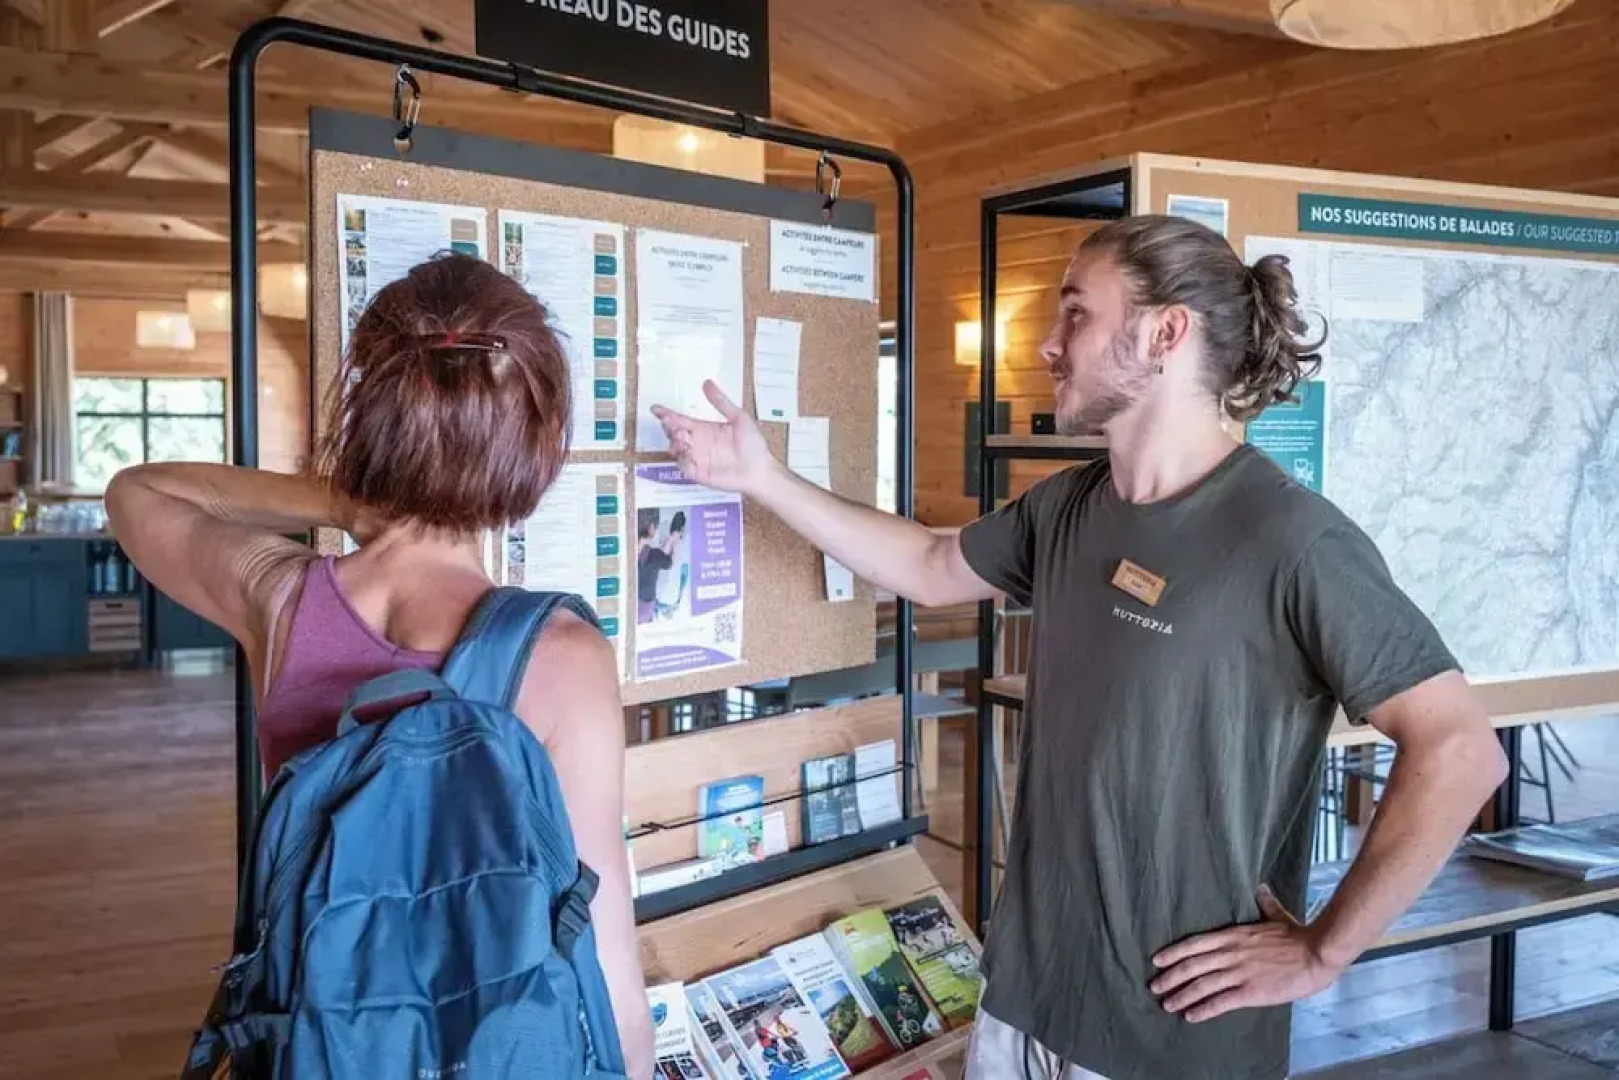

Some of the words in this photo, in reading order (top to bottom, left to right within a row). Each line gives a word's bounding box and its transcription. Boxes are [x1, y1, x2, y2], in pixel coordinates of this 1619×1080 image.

[616, 2, 661, 36] DES
[667, 14, 751, 59] GUIDES
[1311, 206, 1342, 224] NOS
[1344, 210, 1437, 232] SUGGESTIONS
[1440, 216, 1457, 233] DE
[1459, 218, 1514, 237] BALADES
[1523, 224, 1549, 241] OUR
[1550, 226, 1612, 245] SUGGESTED
